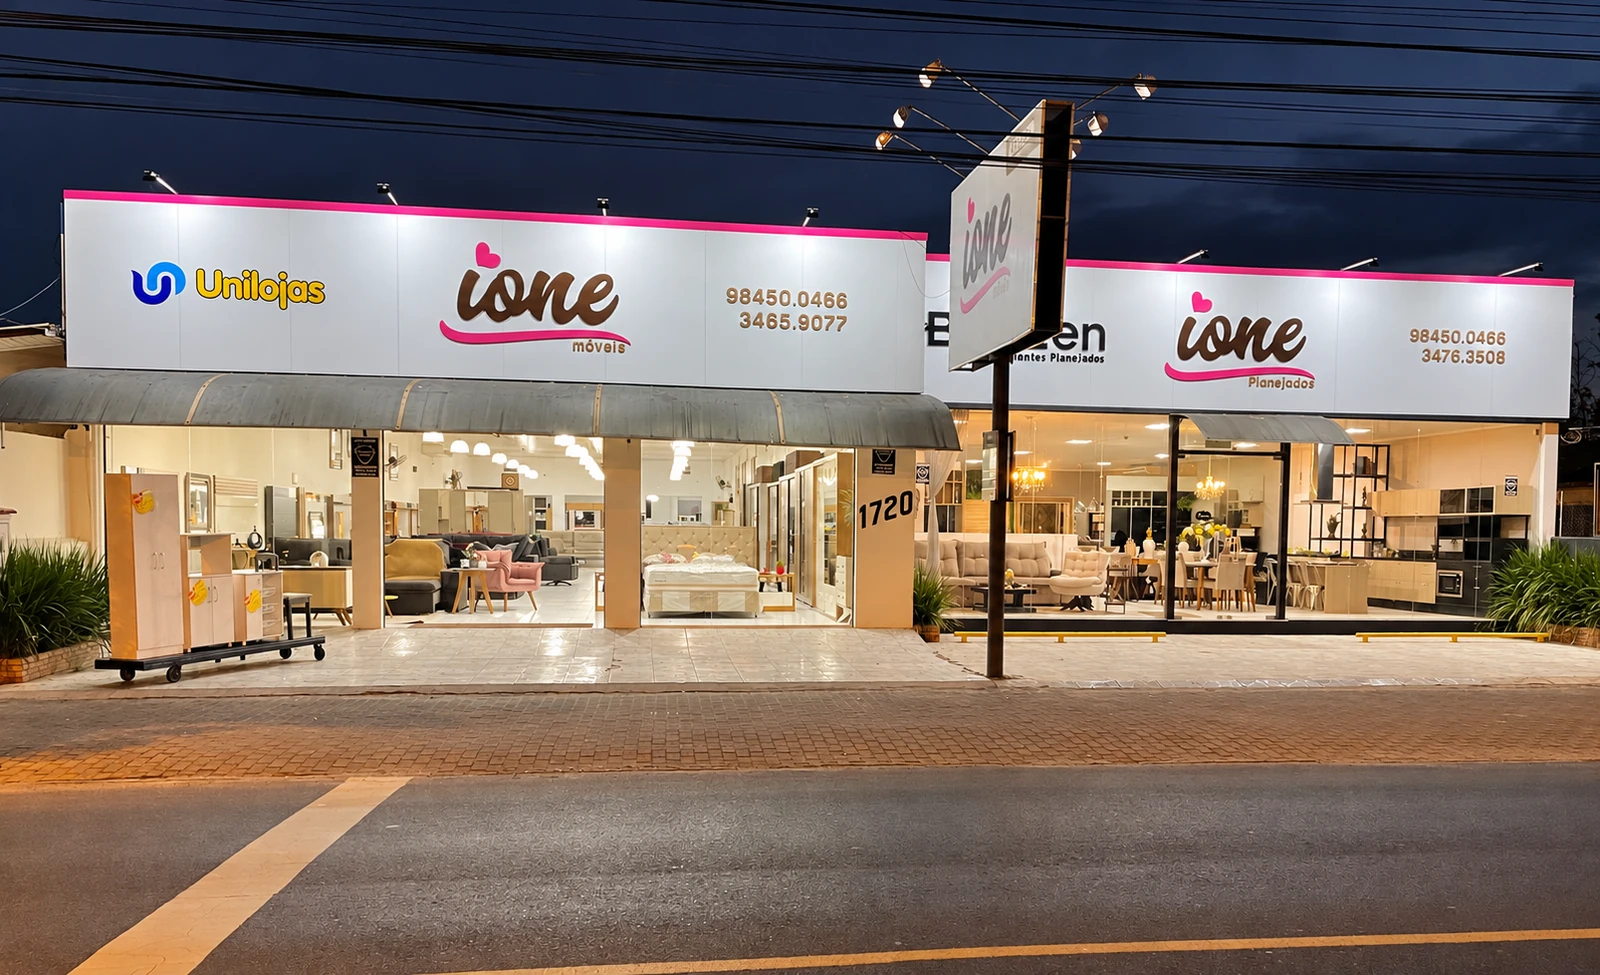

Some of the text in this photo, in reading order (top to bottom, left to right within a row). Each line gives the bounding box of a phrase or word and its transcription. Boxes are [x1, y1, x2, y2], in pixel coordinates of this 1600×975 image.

[963, 192, 1012, 290] ione
[196, 267, 326, 311] Unilojas
[456, 241, 619, 326] ione
[726, 287, 848, 309] 98450.0466
[739, 311, 848, 333] 3465.9077
[1177, 291, 1307, 363] ione
[572, 339, 627, 354] móveis
[1409, 328, 1506, 346] 98450.0466
[1050, 352, 1105, 364] Planejados
[1421, 348, 1506, 365] 3476.3508
[1248, 376, 1316, 391] Planejados
[859, 490, 913, 529] 1720
